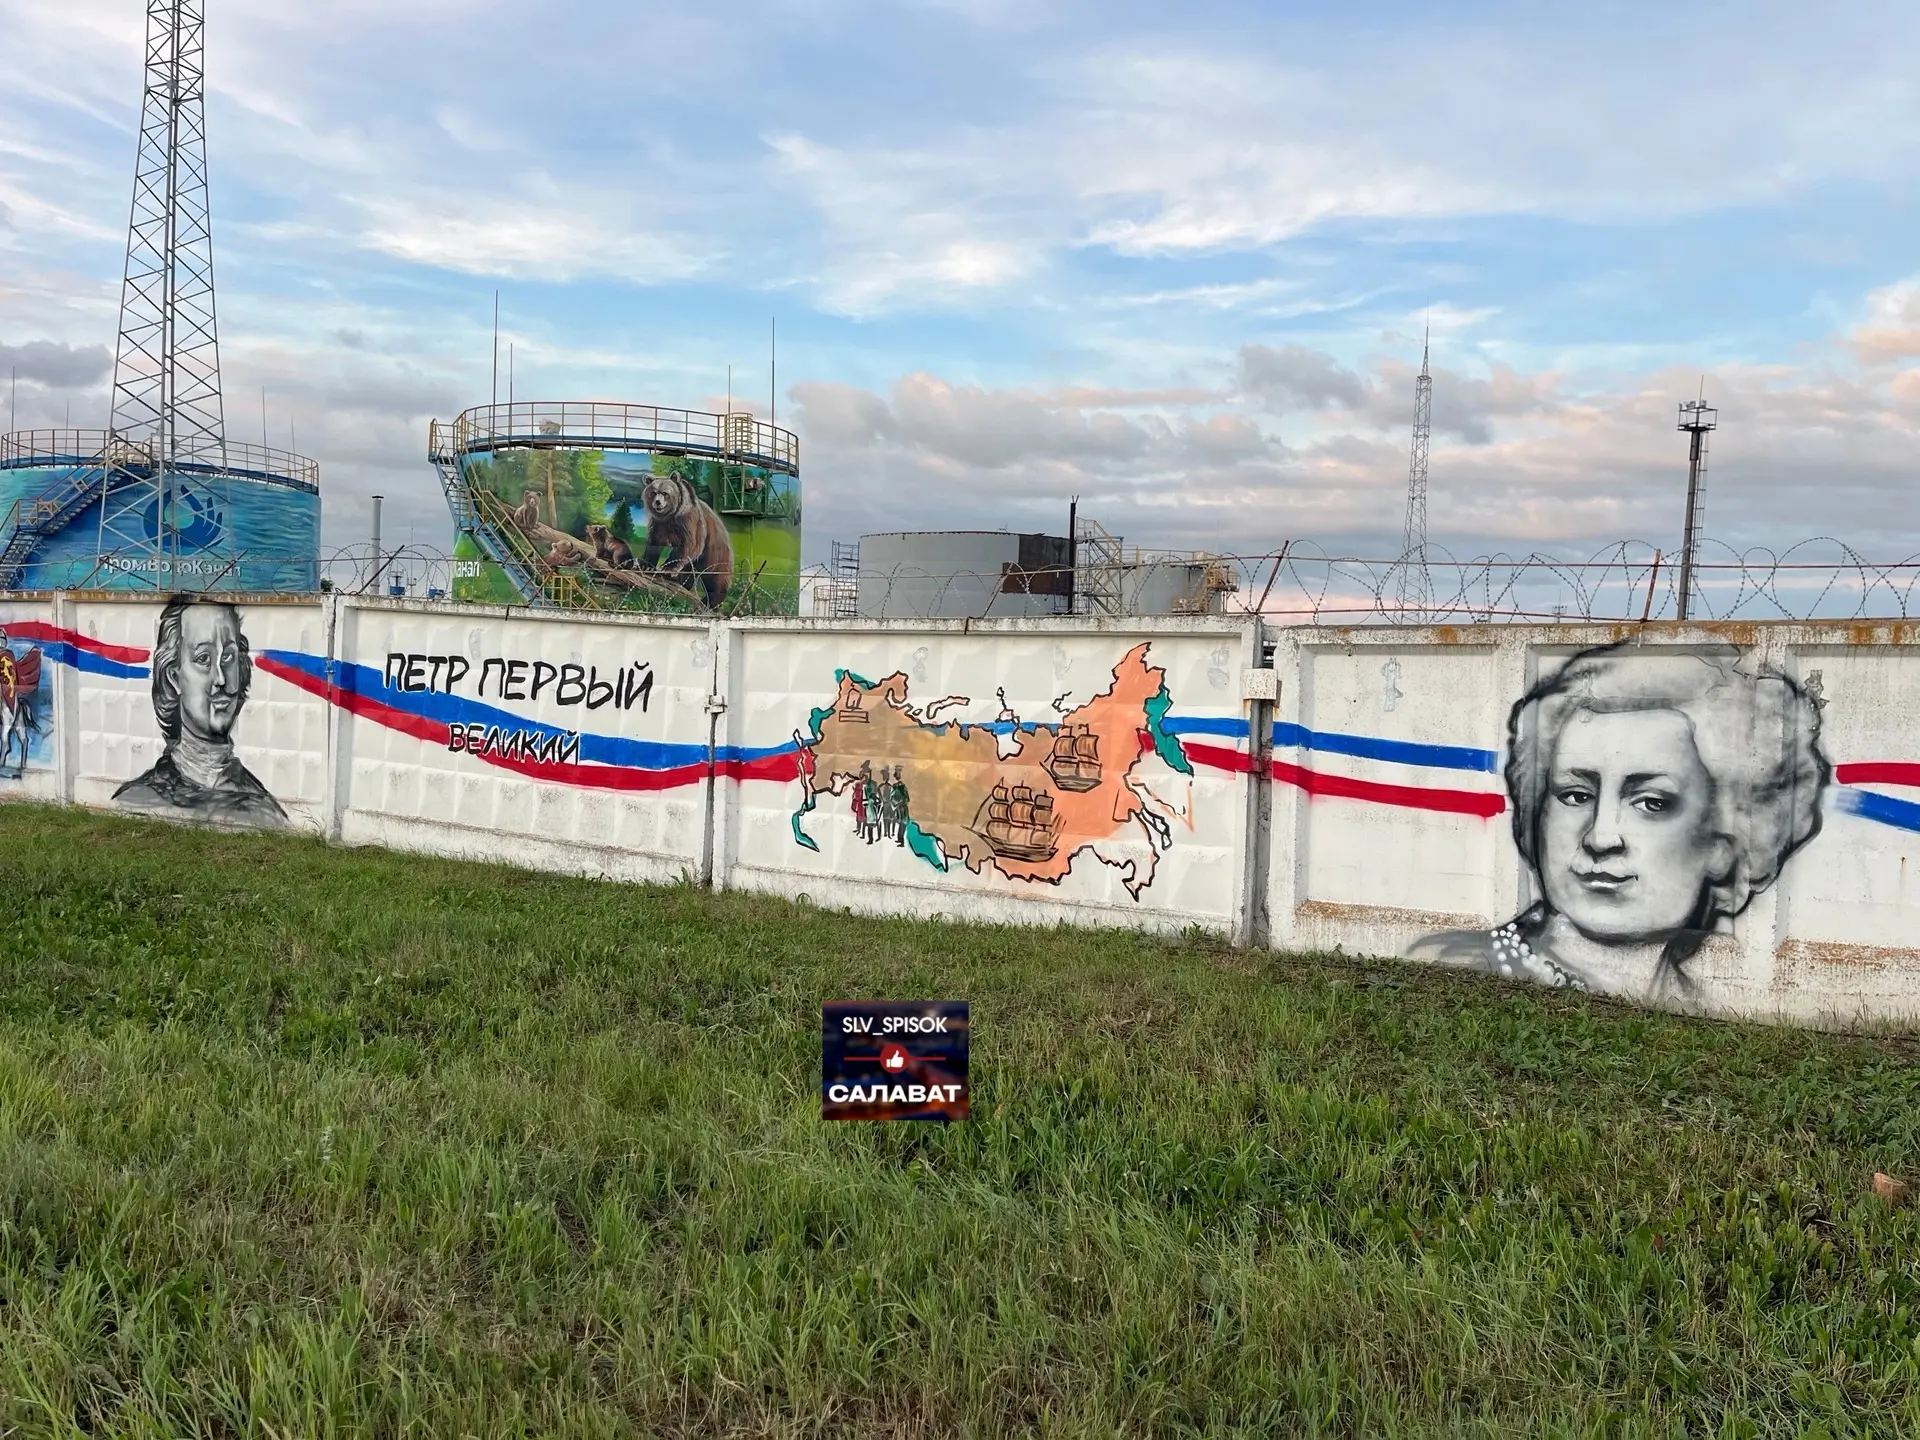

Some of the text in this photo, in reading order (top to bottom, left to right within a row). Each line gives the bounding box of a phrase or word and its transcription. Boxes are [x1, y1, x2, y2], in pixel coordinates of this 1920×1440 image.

[384, 653, 654, 713] ПЕТР ПЕРВЫЙ
[447, 722, 580, 766] ВЕЛИКИЙ
